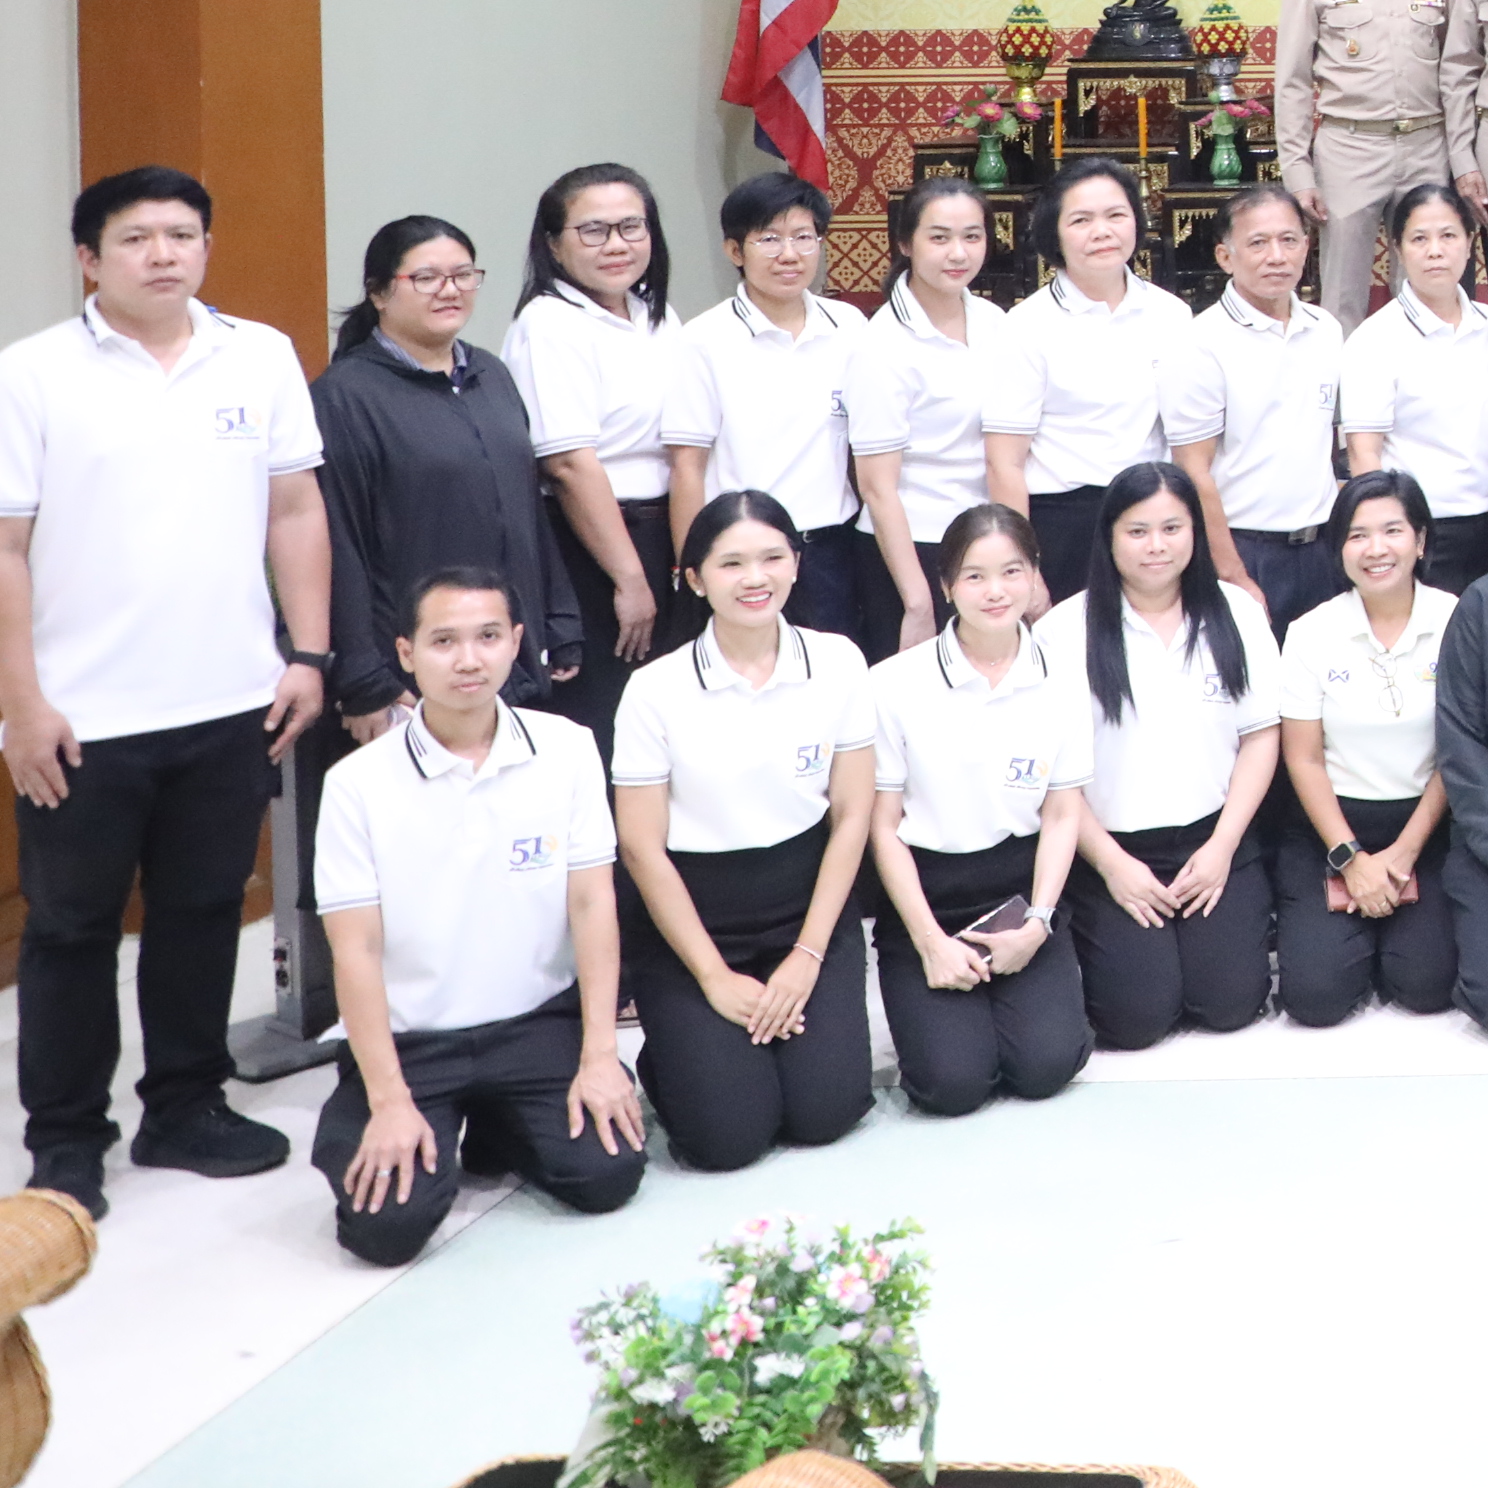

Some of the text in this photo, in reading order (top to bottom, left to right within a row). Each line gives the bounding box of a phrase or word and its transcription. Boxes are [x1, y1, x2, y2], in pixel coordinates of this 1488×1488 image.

[215, 407, 246, 434] 51
[795, 743, 821, 771] 51
[1006, 757, 1036, 783] 51
[509, 835, 543, 867] 51
